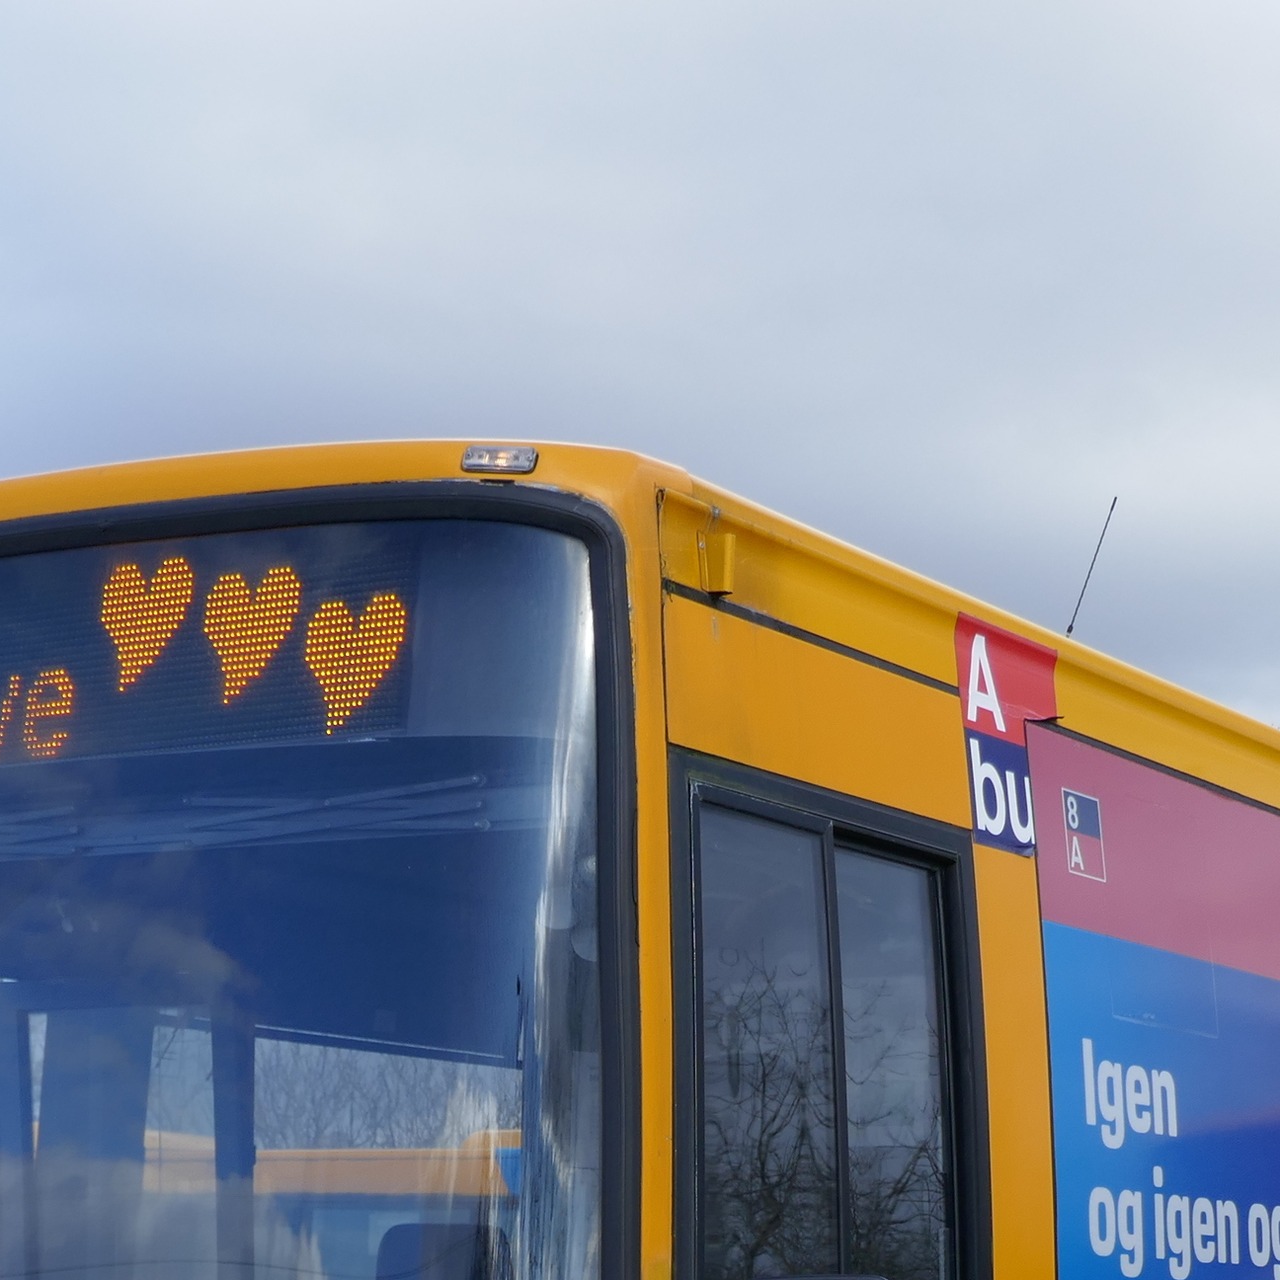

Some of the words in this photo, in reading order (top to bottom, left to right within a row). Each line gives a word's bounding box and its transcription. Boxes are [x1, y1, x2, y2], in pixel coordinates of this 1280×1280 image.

[967, 634, 1007, 733] A
[1066, 795, 1080, 830] 8
[1070, 835, 1085, 871] A
[1082, 1037, 1178, 1150] Igen
[1088, 1186, 1145, 1279] og
